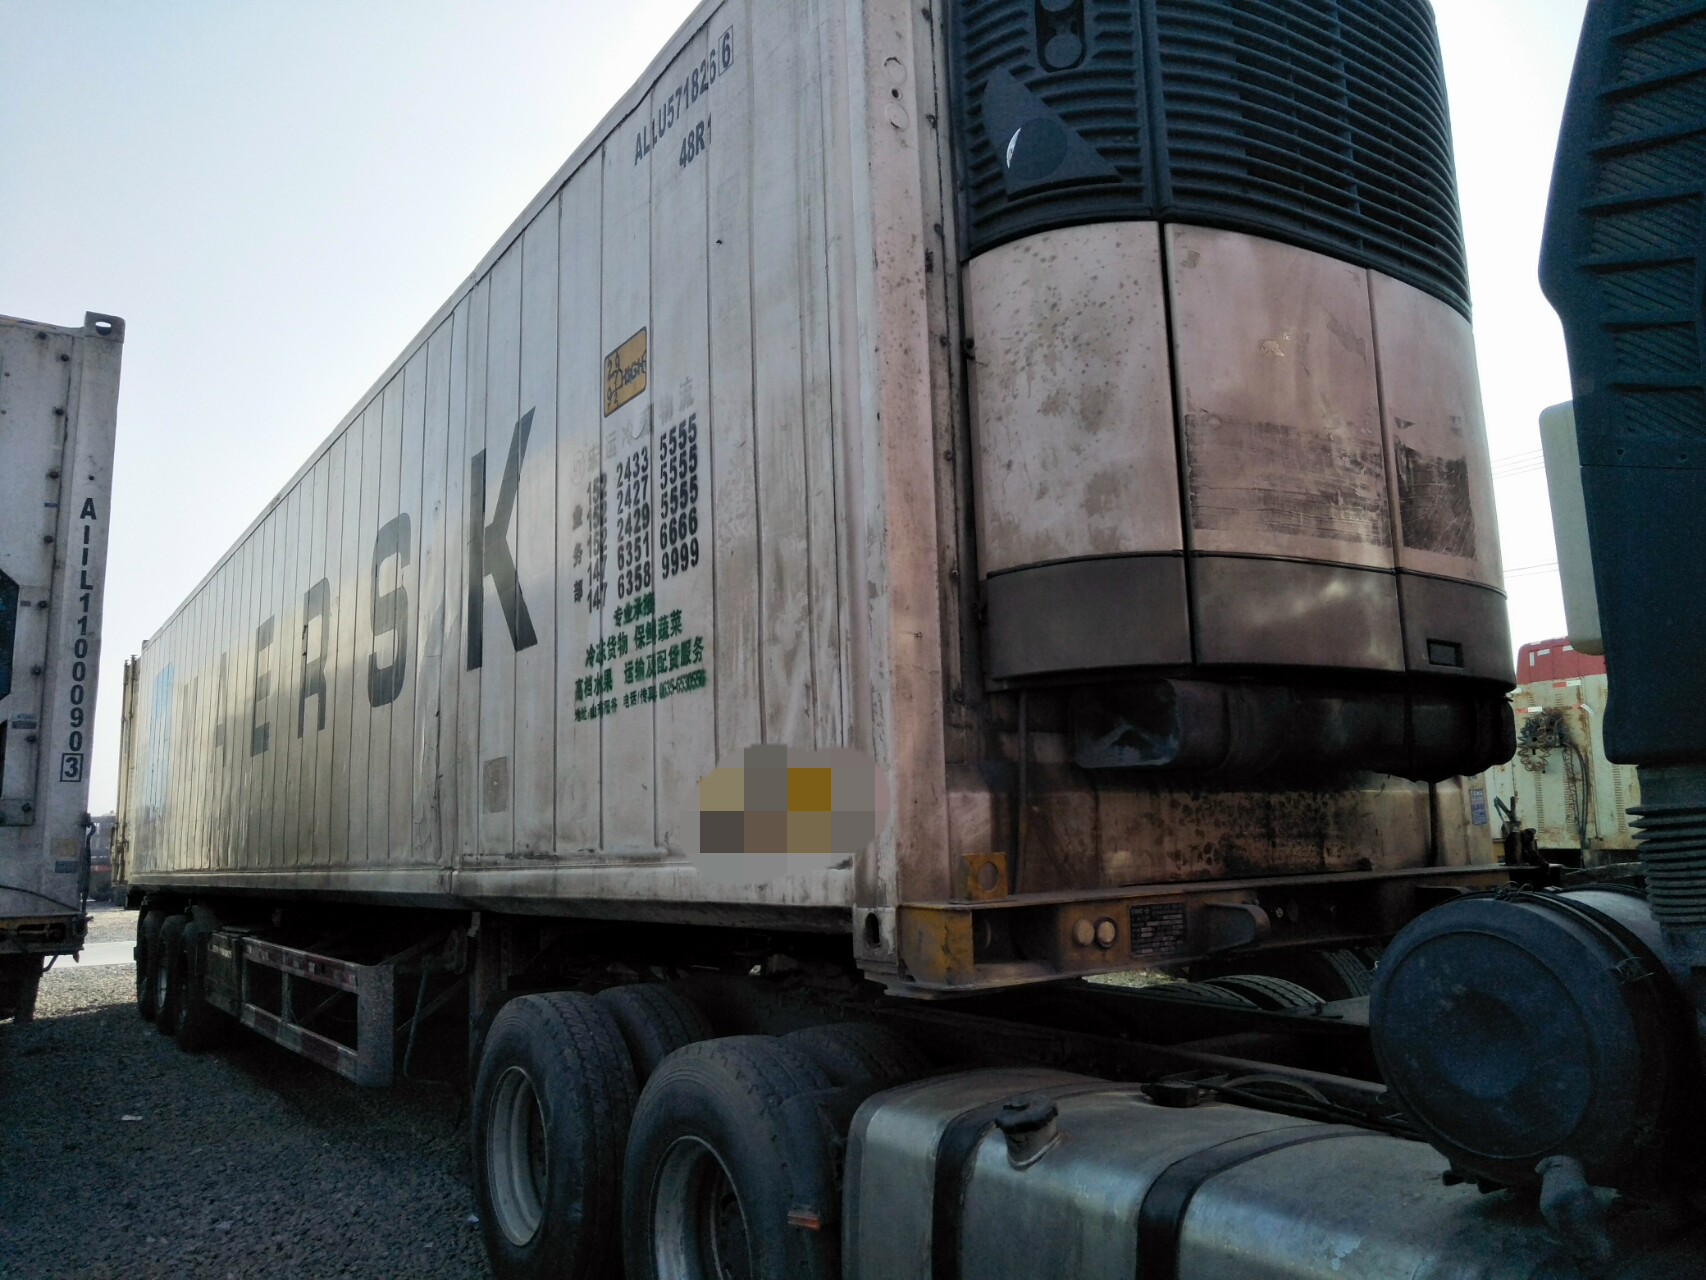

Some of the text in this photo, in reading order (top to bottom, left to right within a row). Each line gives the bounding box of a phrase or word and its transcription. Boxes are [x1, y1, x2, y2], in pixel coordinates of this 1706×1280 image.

[616, 446, 649, 489] 2433
[660, 412, 697, 461] 5555
[616, 474, 649, 515] 2427
[660, 443, 698, 491] 5555
[616, 502, 650, 543] 2429
[661, 473, 699, 520] 5555
[617, 531, 650, 571] 6351
[660, 506, 698, 551] 6666
[617, 560, 651, 600] 6358
[661, 536, 699, 580] 9999
